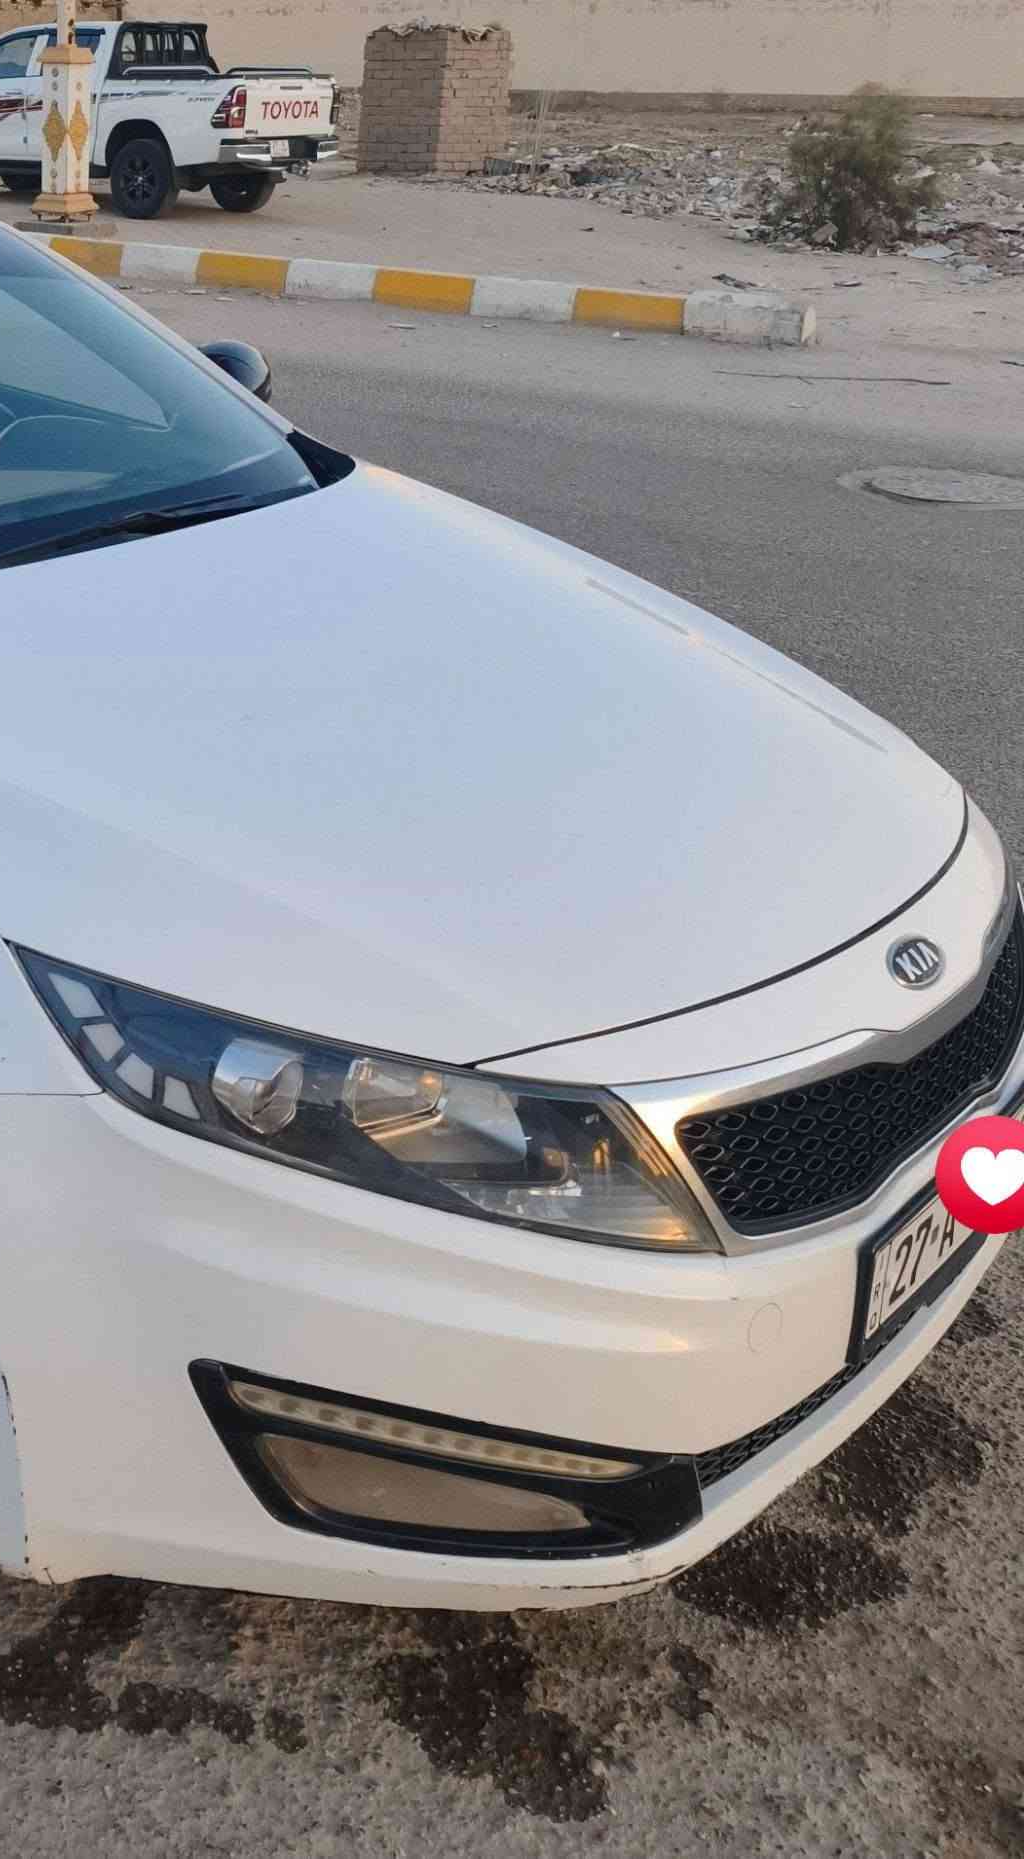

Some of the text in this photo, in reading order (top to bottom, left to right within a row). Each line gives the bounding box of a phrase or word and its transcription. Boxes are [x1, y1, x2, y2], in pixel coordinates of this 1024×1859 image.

[261, 100, 319, 121] TOYOTA
[896, 941, 938, 980] KIA
[888, 1213, 933, 1306] 27
